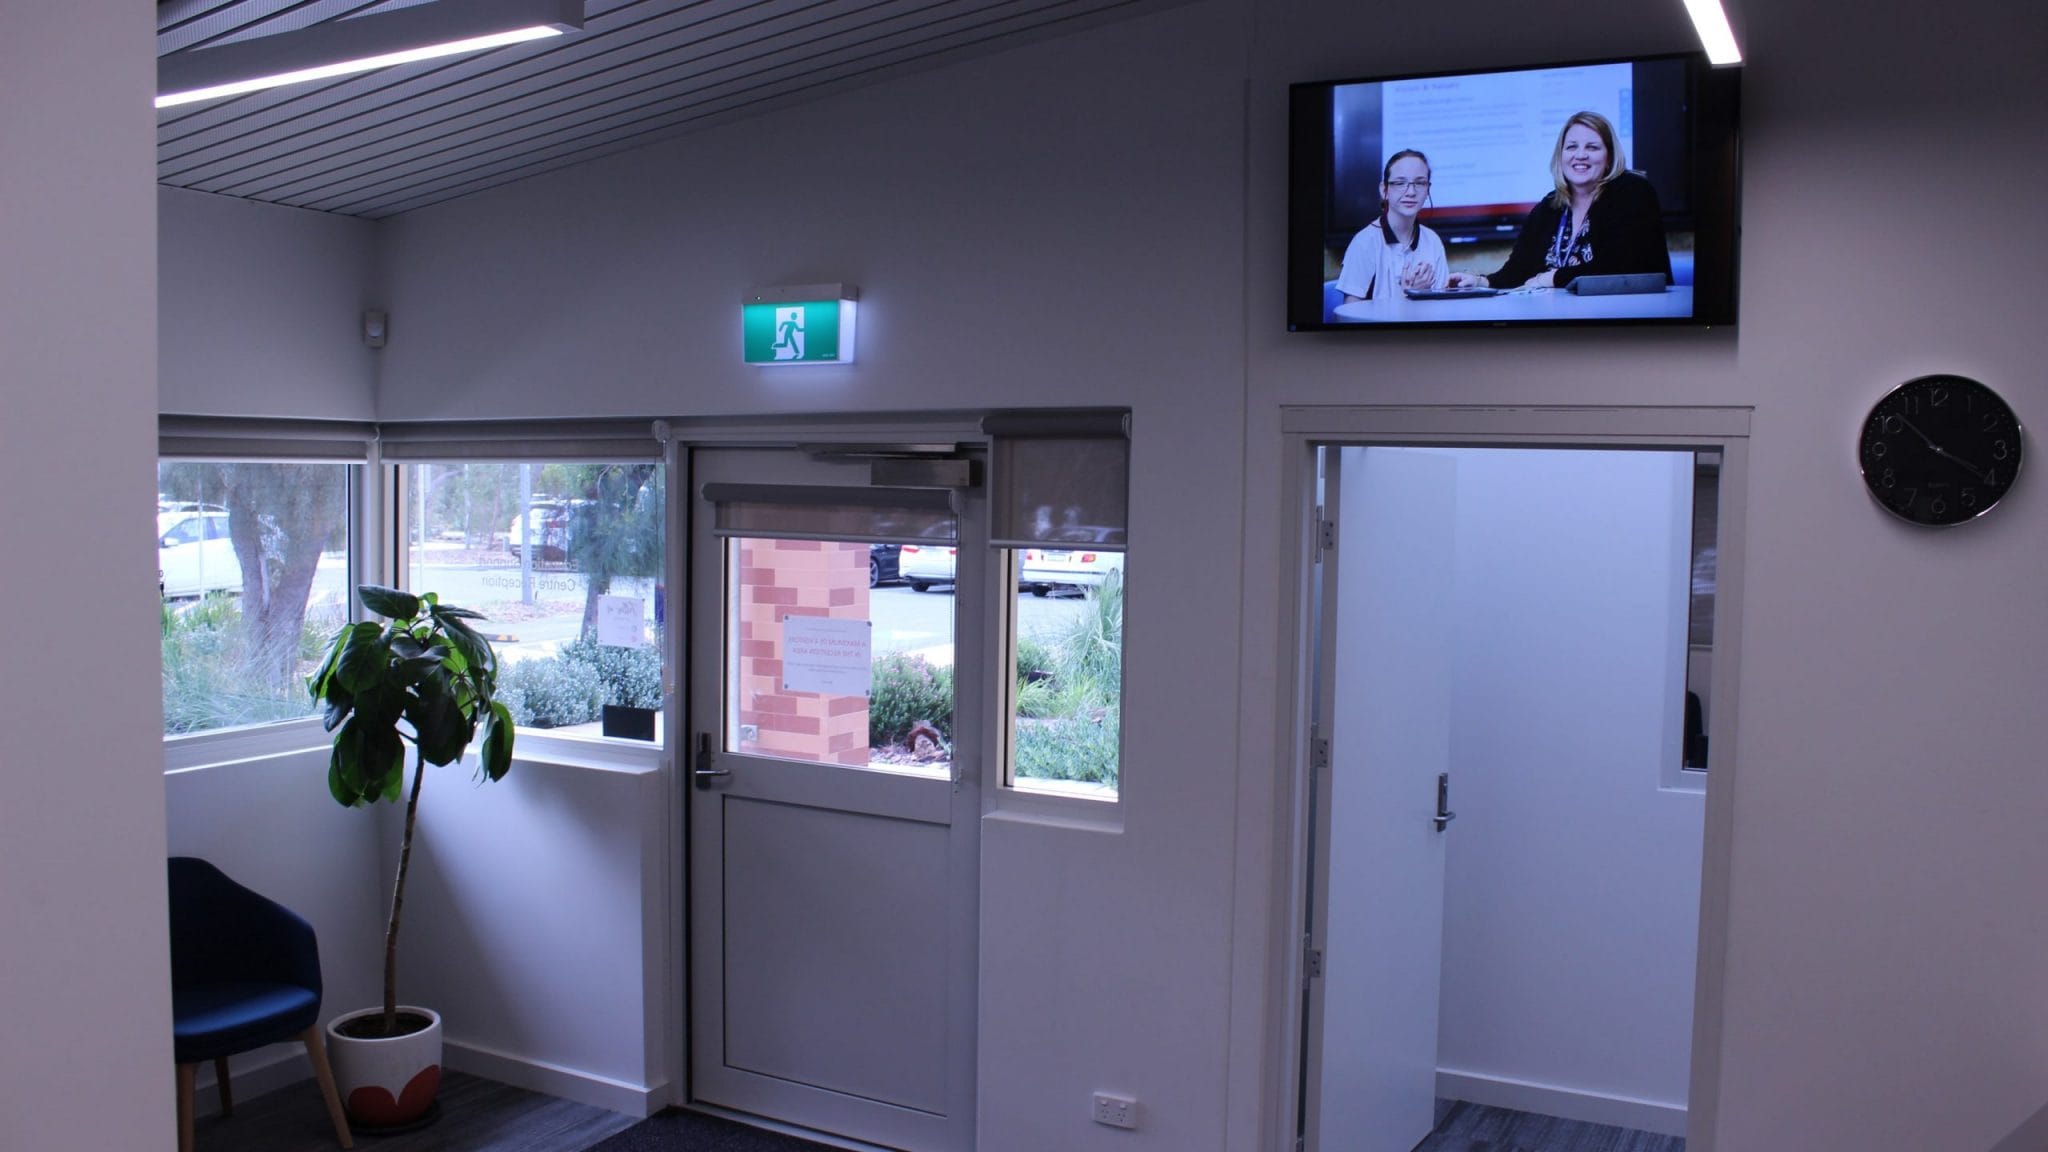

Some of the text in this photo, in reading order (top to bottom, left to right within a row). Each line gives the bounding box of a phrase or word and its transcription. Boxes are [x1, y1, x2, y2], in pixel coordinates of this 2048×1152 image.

[1903, 396, 1919, 415] 11
[1929, 387, 1949, 407] 12
[1880, 414, 1903, 434] 10
[1983, 414, 1999, 432] 2
[1871, 441, 1888, 461] 9
[1992, 439, 2008, 461] 3
[1881, 468, 1896, 488] 8
[1982, 468, 1997, 487] 4
[1903, 487, 1918, 508] 7
[1930, 493, 1947, 514] 6
[1960, 487, 1976, 508] 5
